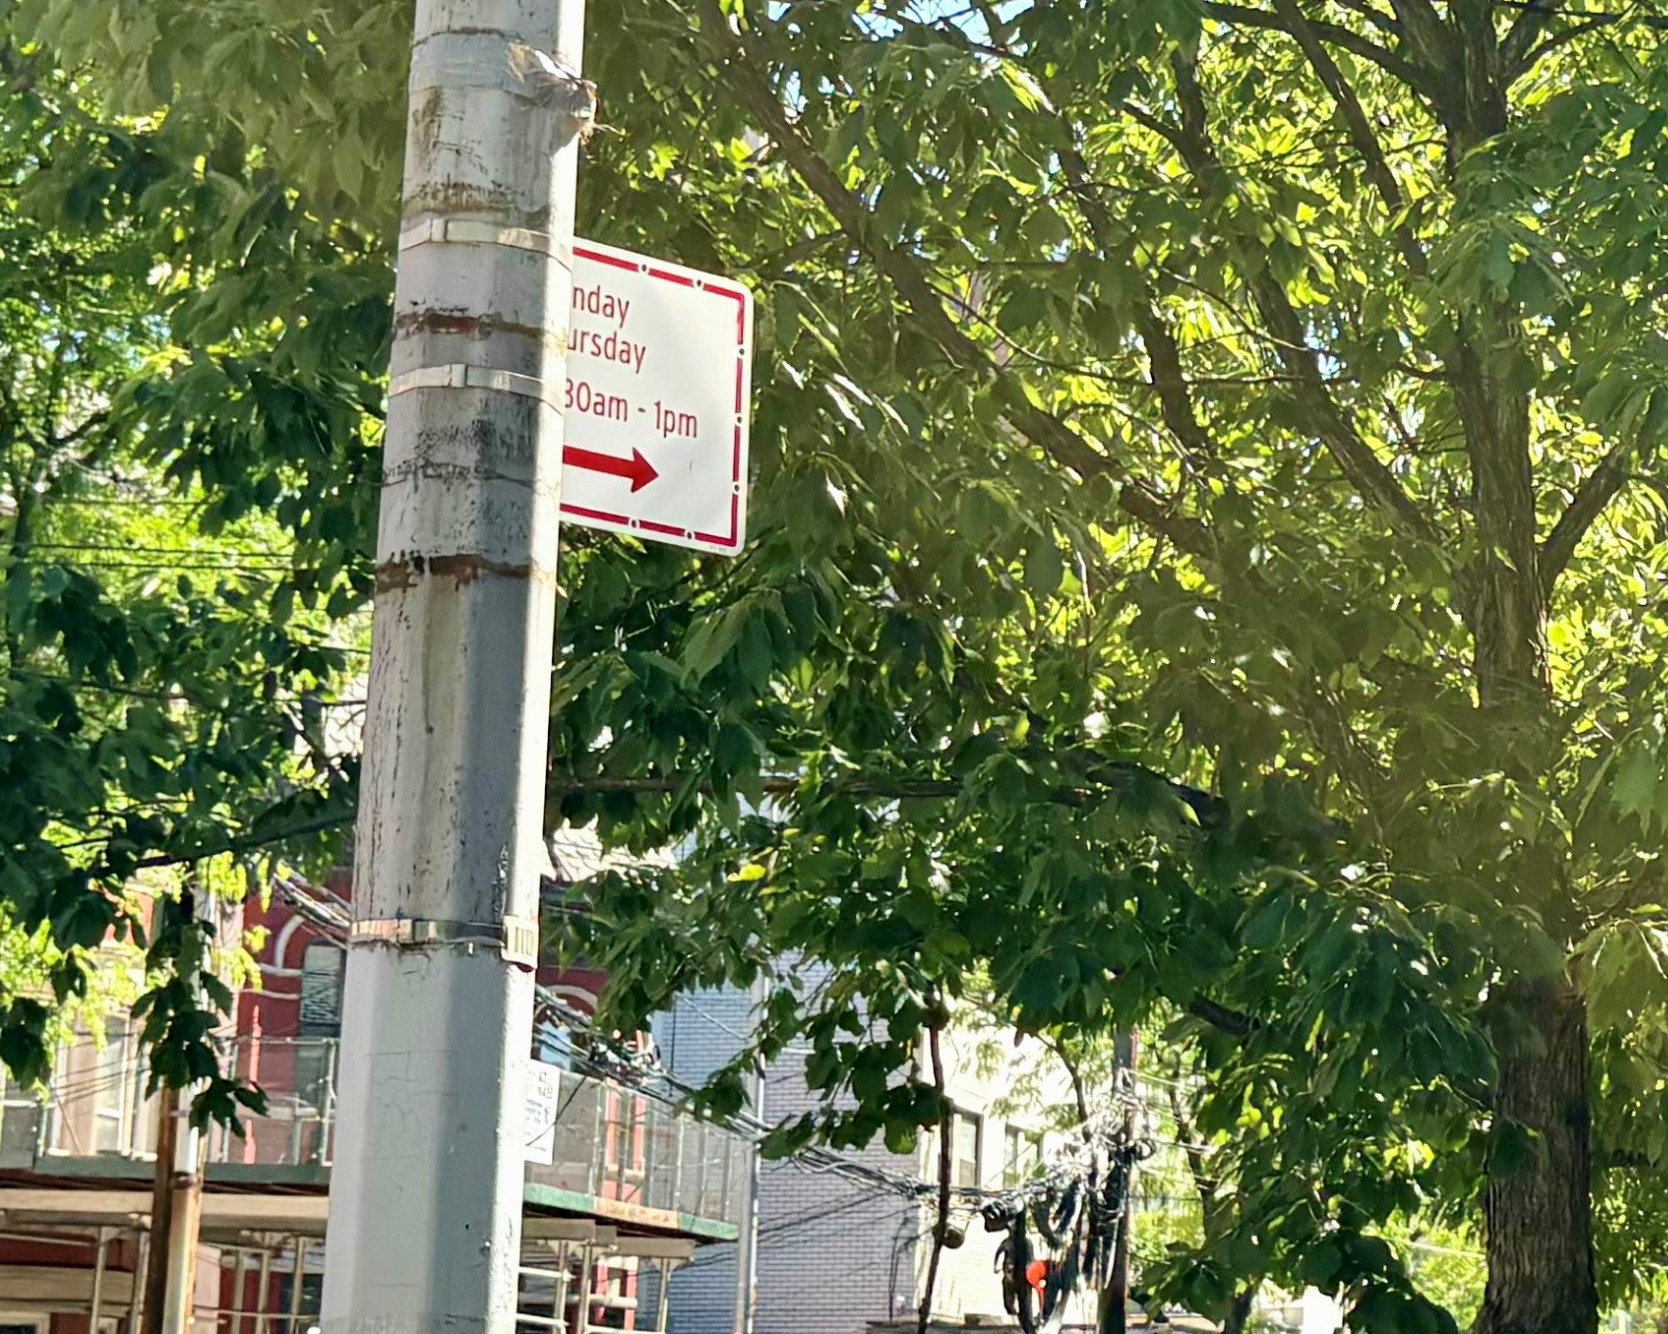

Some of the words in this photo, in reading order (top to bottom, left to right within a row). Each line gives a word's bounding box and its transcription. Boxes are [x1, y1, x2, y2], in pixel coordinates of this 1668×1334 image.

[572, 284, 630, 329] nday
[567, 328, 646, 375] ursday
[564, 377, 628, 422] 30am
[653, 399, 698, 439] 1pm
